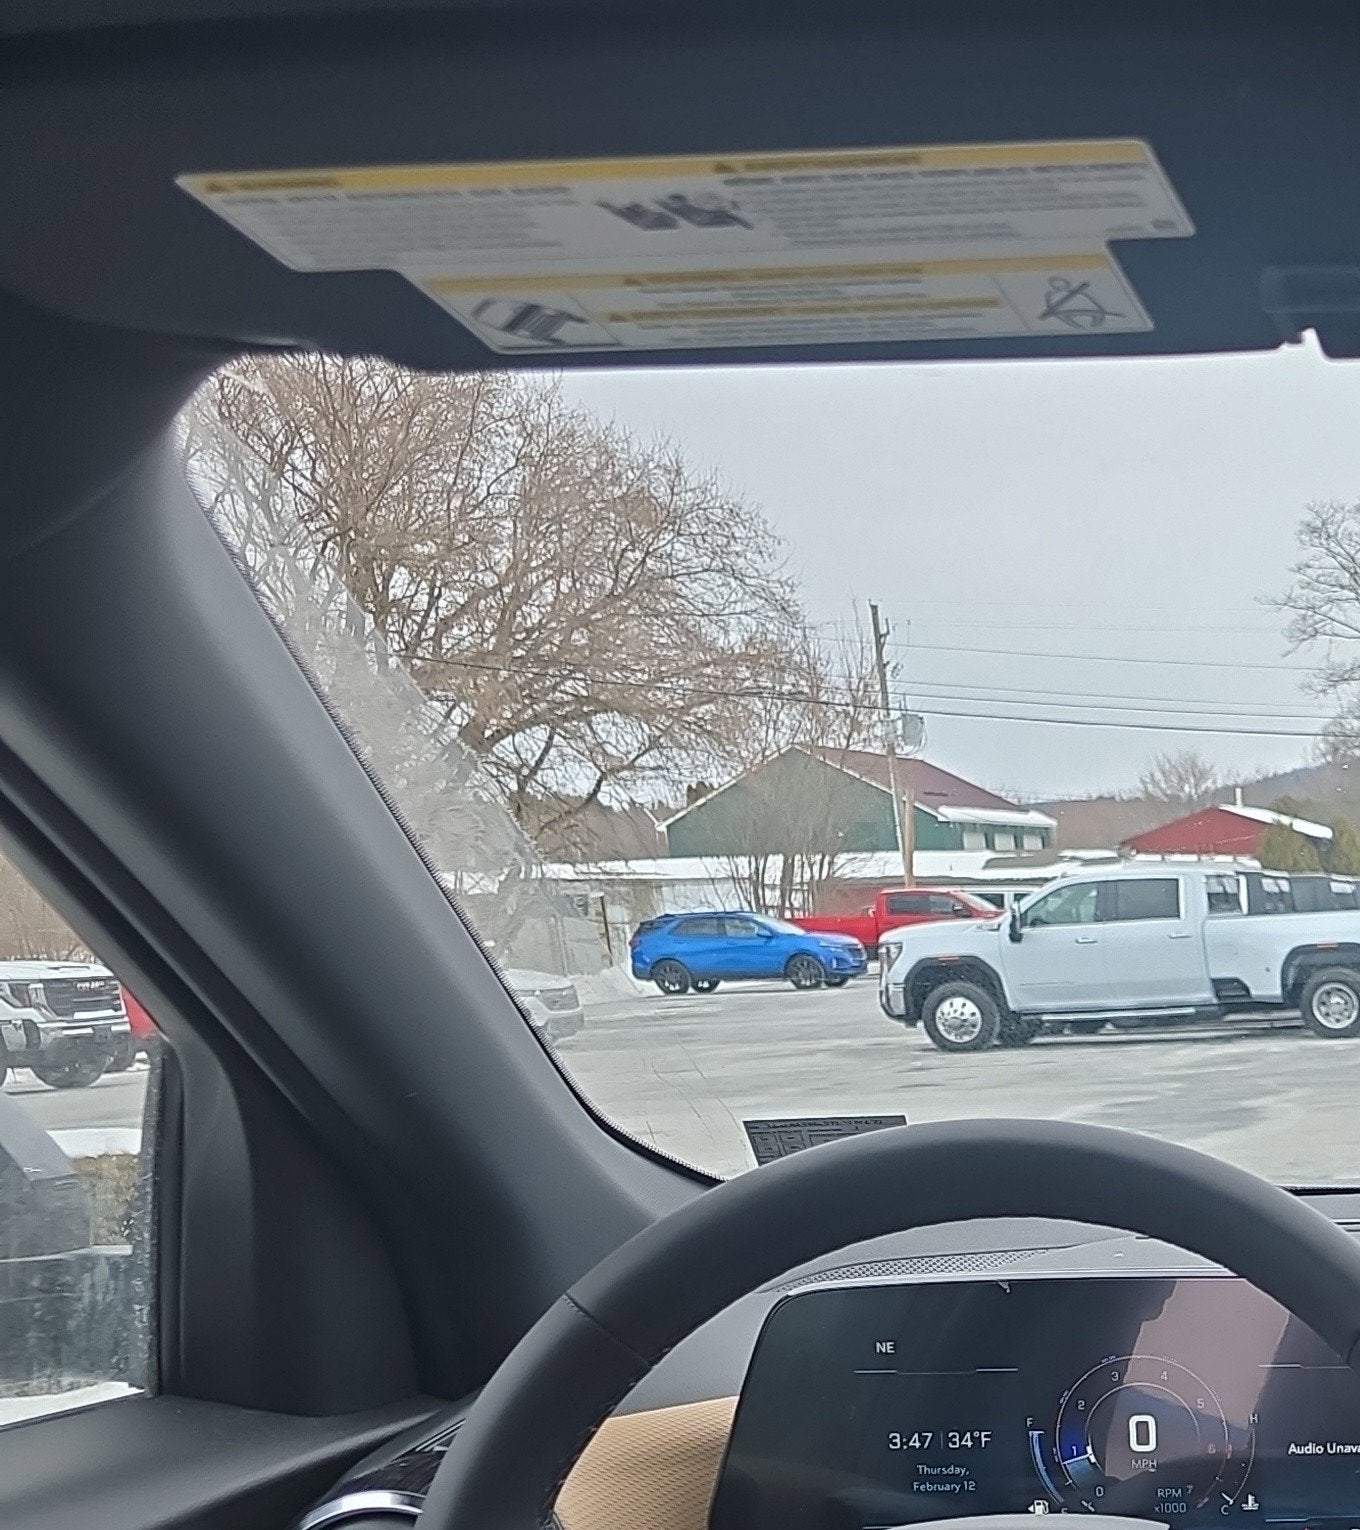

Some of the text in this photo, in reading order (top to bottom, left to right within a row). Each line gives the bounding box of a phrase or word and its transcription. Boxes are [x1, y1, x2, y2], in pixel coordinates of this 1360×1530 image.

[875, 1341, 896, 1354] NE
[1110, 1371, 1119, 1381] 3
[1160, 1370, 1168, 1381] 4
[1077, 1400, 1086, 1410] 2
[1196, 1398, 1205, 1409] 5
[1026, 1417, 1034, 1427] F
[1250, 1413, 1258, 1424] H
[1128, 1414, 1157, 1452] 0
[888, 1430, 992, 1449] 3:47 34°F
[1070, 1445, 1078, 1456] 1
[1288, 1442, 1325, 1455] Audio
[1131, 1459, 1158, 1469] MPH
[916, 1464, 970, 1477] Thursday,
[913, 1480, 976, 1494] February 12
[1095, 1486, 1104, 1497] 0
[1157, 1488, 1182, 1498] RPM
[1220, 1504, 1229, 1515] C
